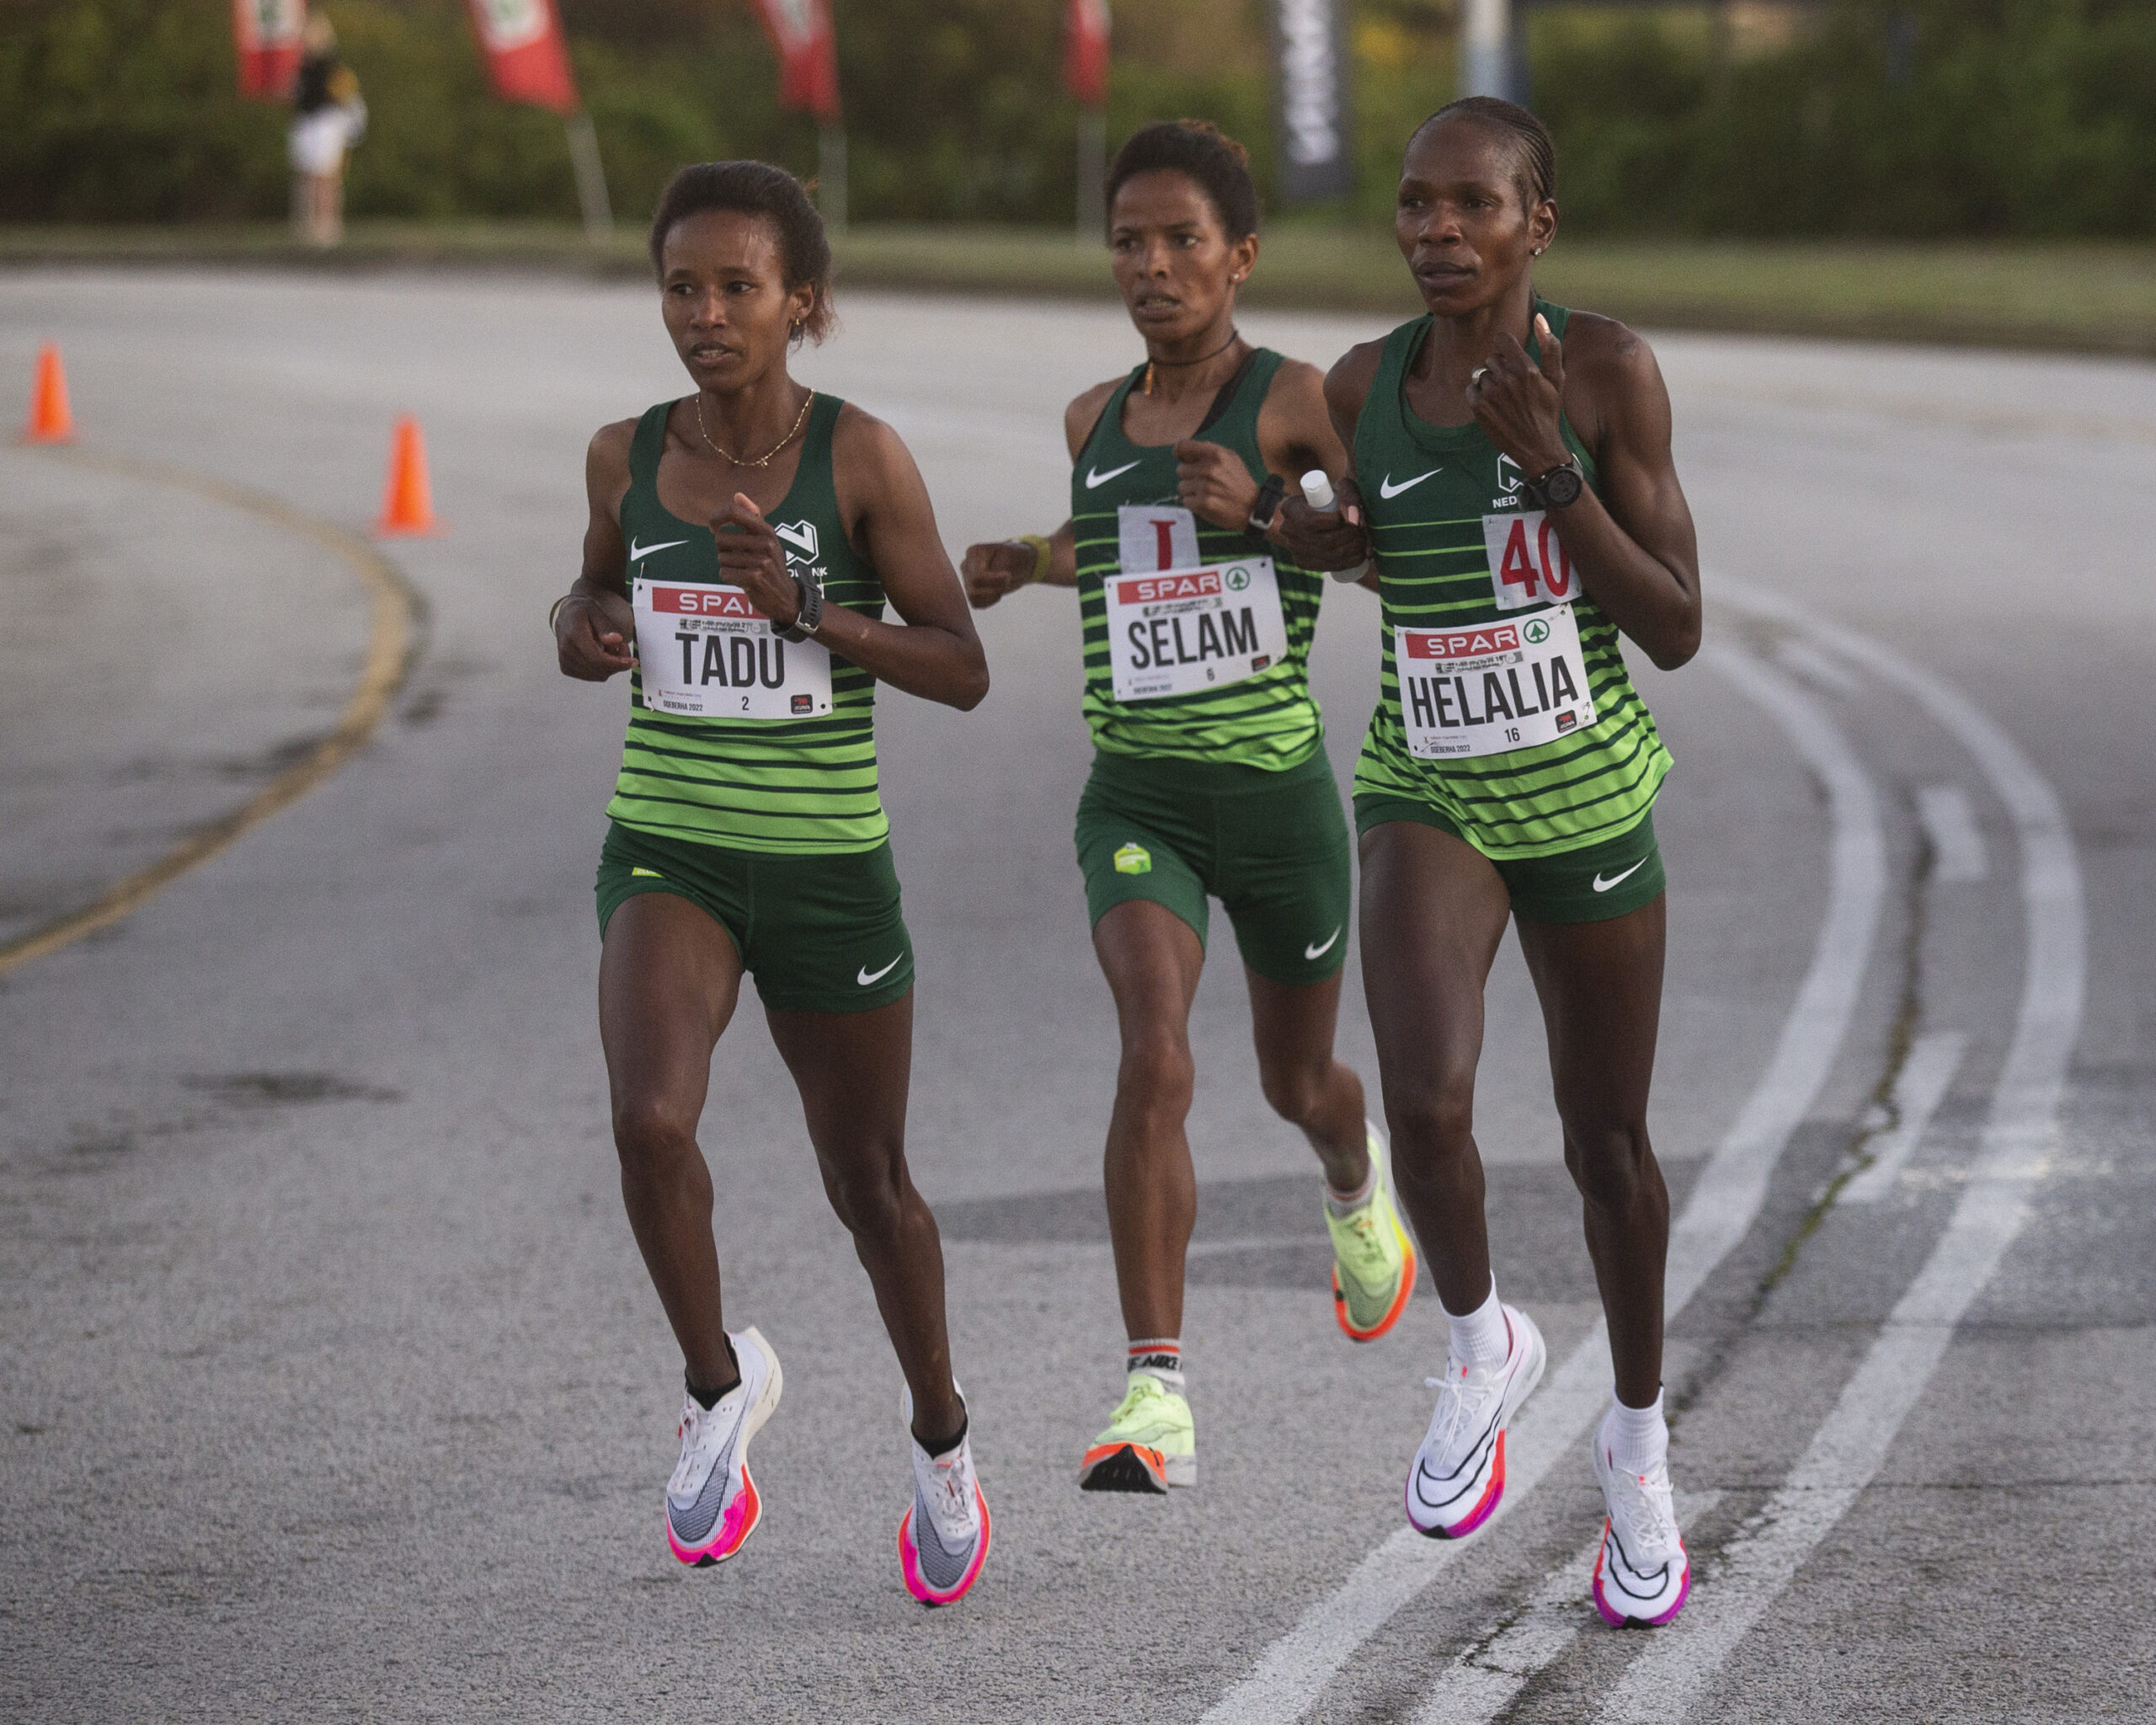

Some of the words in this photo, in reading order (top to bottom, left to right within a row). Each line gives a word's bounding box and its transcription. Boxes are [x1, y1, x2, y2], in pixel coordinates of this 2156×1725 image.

[1500, 519, 1571, 598] 40
[1137, 574, 1220, 601] SPAR
[1128, 606, 1259, 670] SELAM
[1427, 628, 1518, 656] SPAR
[675, 632, 785, 689] TADU
[1205, 667, 1215, 682] 6
[741, 696, 750, 711] 2
[1407, 654, 1579, 729] HELALIA
[688, 702, 703, 712] 2022
[1504, 727, 1520, 743] 16
